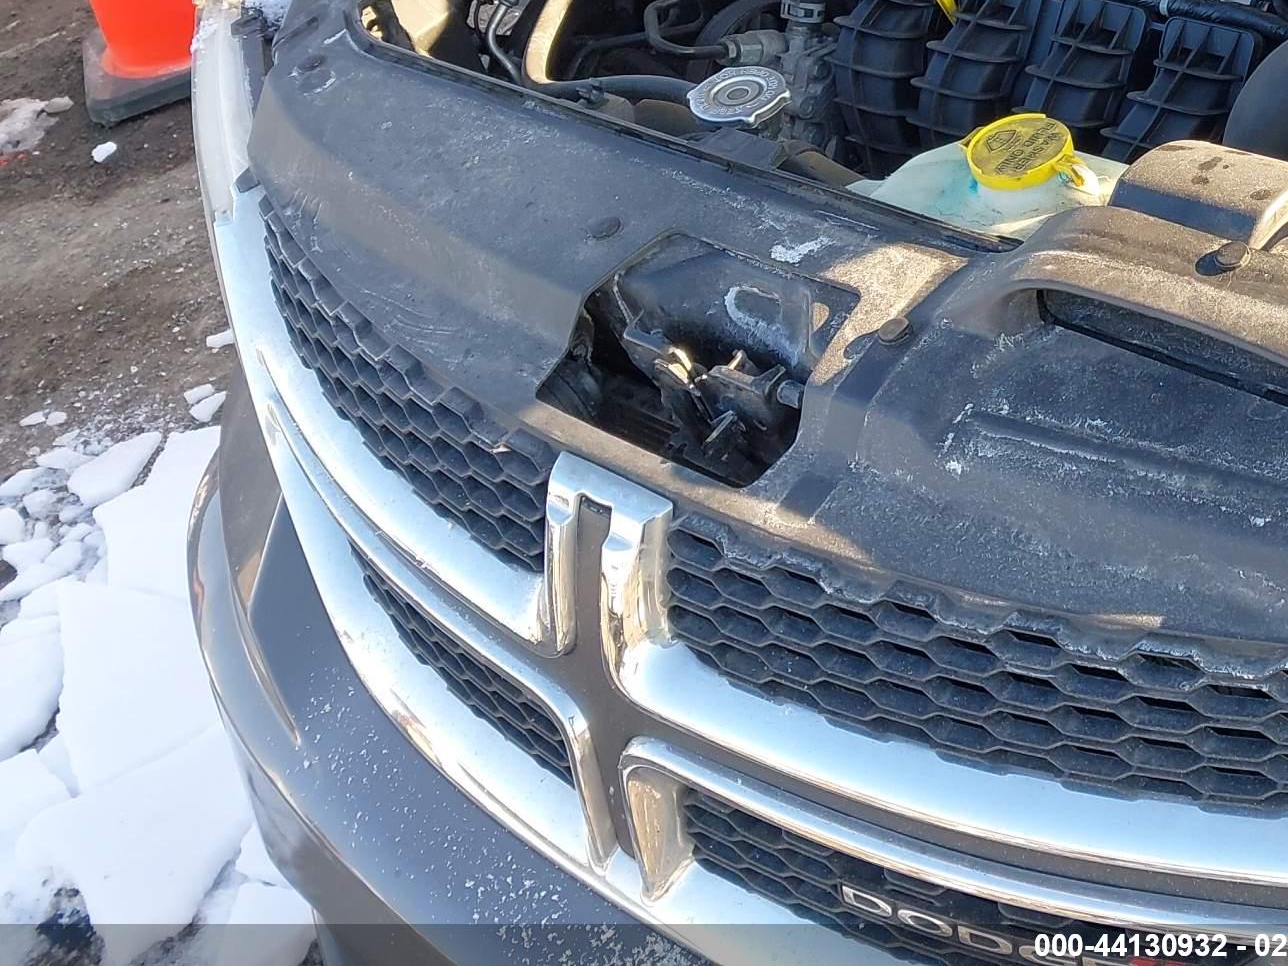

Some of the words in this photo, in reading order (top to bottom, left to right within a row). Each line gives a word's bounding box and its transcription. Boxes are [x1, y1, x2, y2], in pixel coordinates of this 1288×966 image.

[1023, 121, 1057, 148] FLUID
[994, 149, 1024, 175] ONLY
[1015, 132, 1061, 172] WASHER
[842, 885, 1122, 966] DODG
